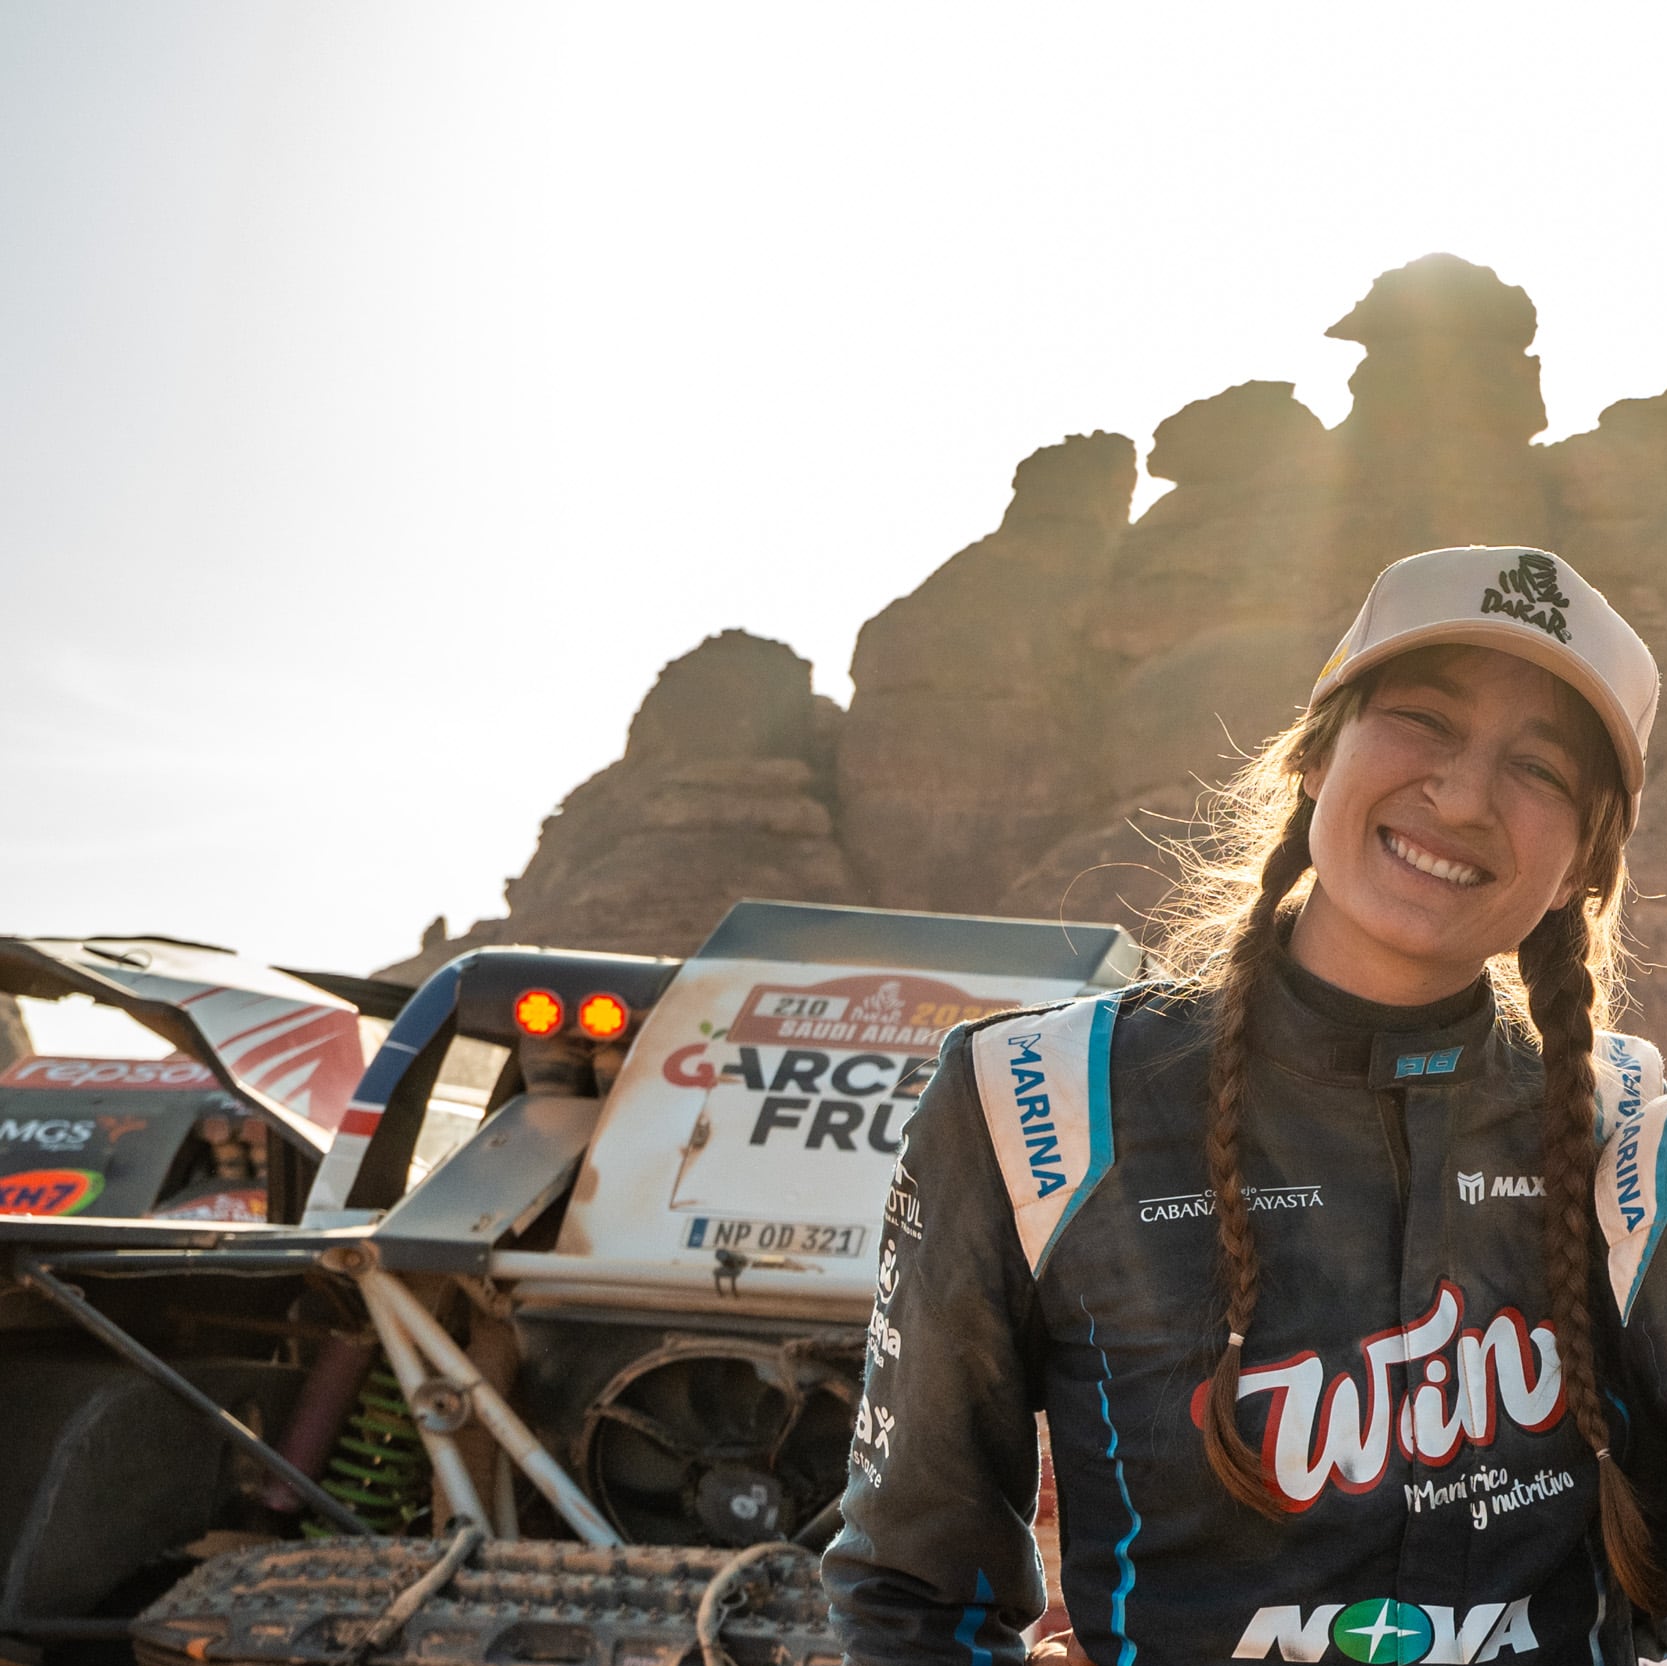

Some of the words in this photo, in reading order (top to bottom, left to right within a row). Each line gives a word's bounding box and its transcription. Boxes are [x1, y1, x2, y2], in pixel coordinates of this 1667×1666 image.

[1481, 588, 1567, 644] DAKAR
[773, 997, 830, 1016] 210
[777, 1020, 856, 1040] SAUDI
[1008, 1032, 1067, 1199] MARINA
[1490, 1176, 1547, 1197] MAX
[1191, 1279, 1569, 1513] Win
[1470, 1465, 1508, 1493] rico
[1470, 1500, 1488, 1530] y
[1491, 1468, 1574, 1515] nutritivo
[1230, 1595, 1540, 1666] NOVA
